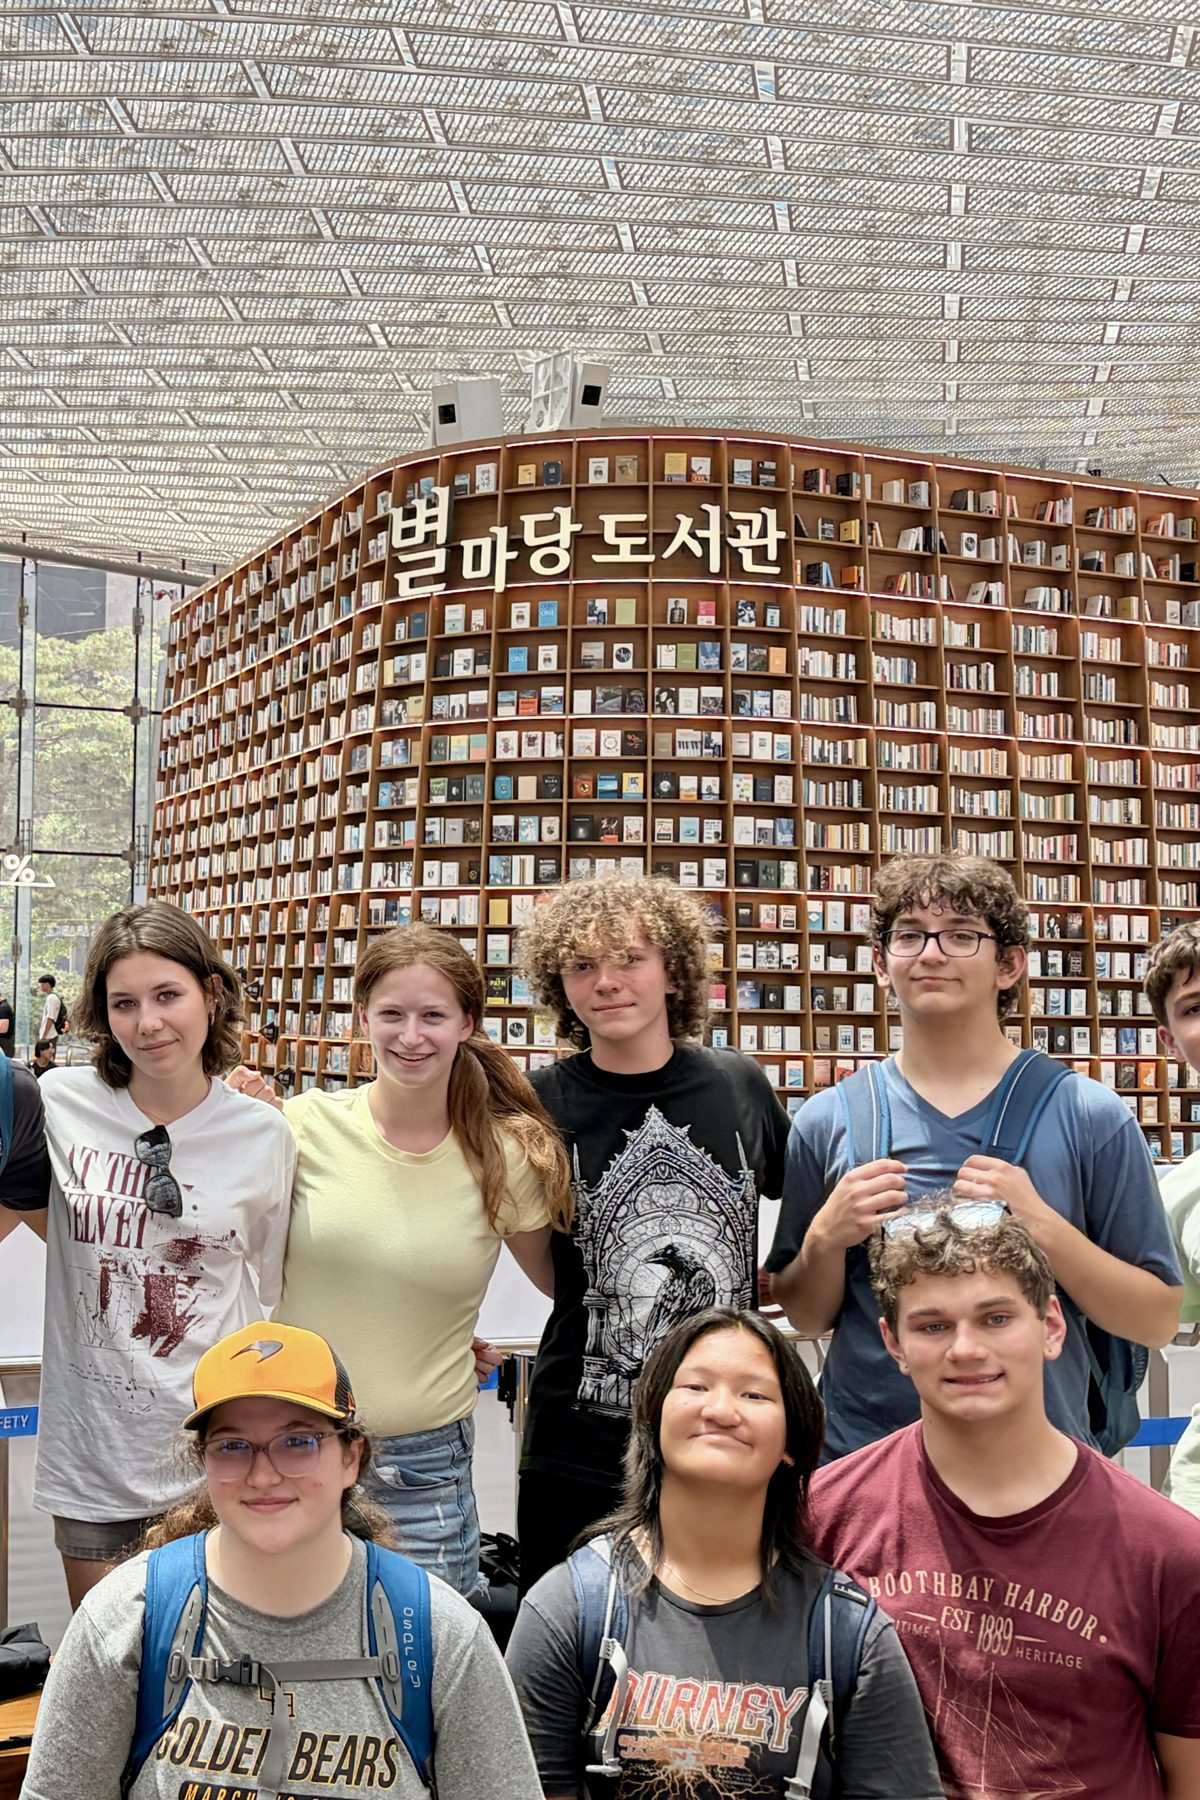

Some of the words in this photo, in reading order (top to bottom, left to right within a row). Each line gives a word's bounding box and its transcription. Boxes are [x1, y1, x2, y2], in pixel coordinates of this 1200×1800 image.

[390, 485, 583, 598] 별마당
[591, 503, 787, 575] 도서관
[63, 1143, 100, 1189] AT
[868, 1570, 995, 1604] BOOTHBAY
[403, 1606, 422, 1689] osprey
[940, 1605, 974, 1634] EST.
[975, 1612, 1014, 1657] 1889
[1016, 1646, 1084, 1670] HERITAGE
[288, 1730, 399, 1789] BEARS
